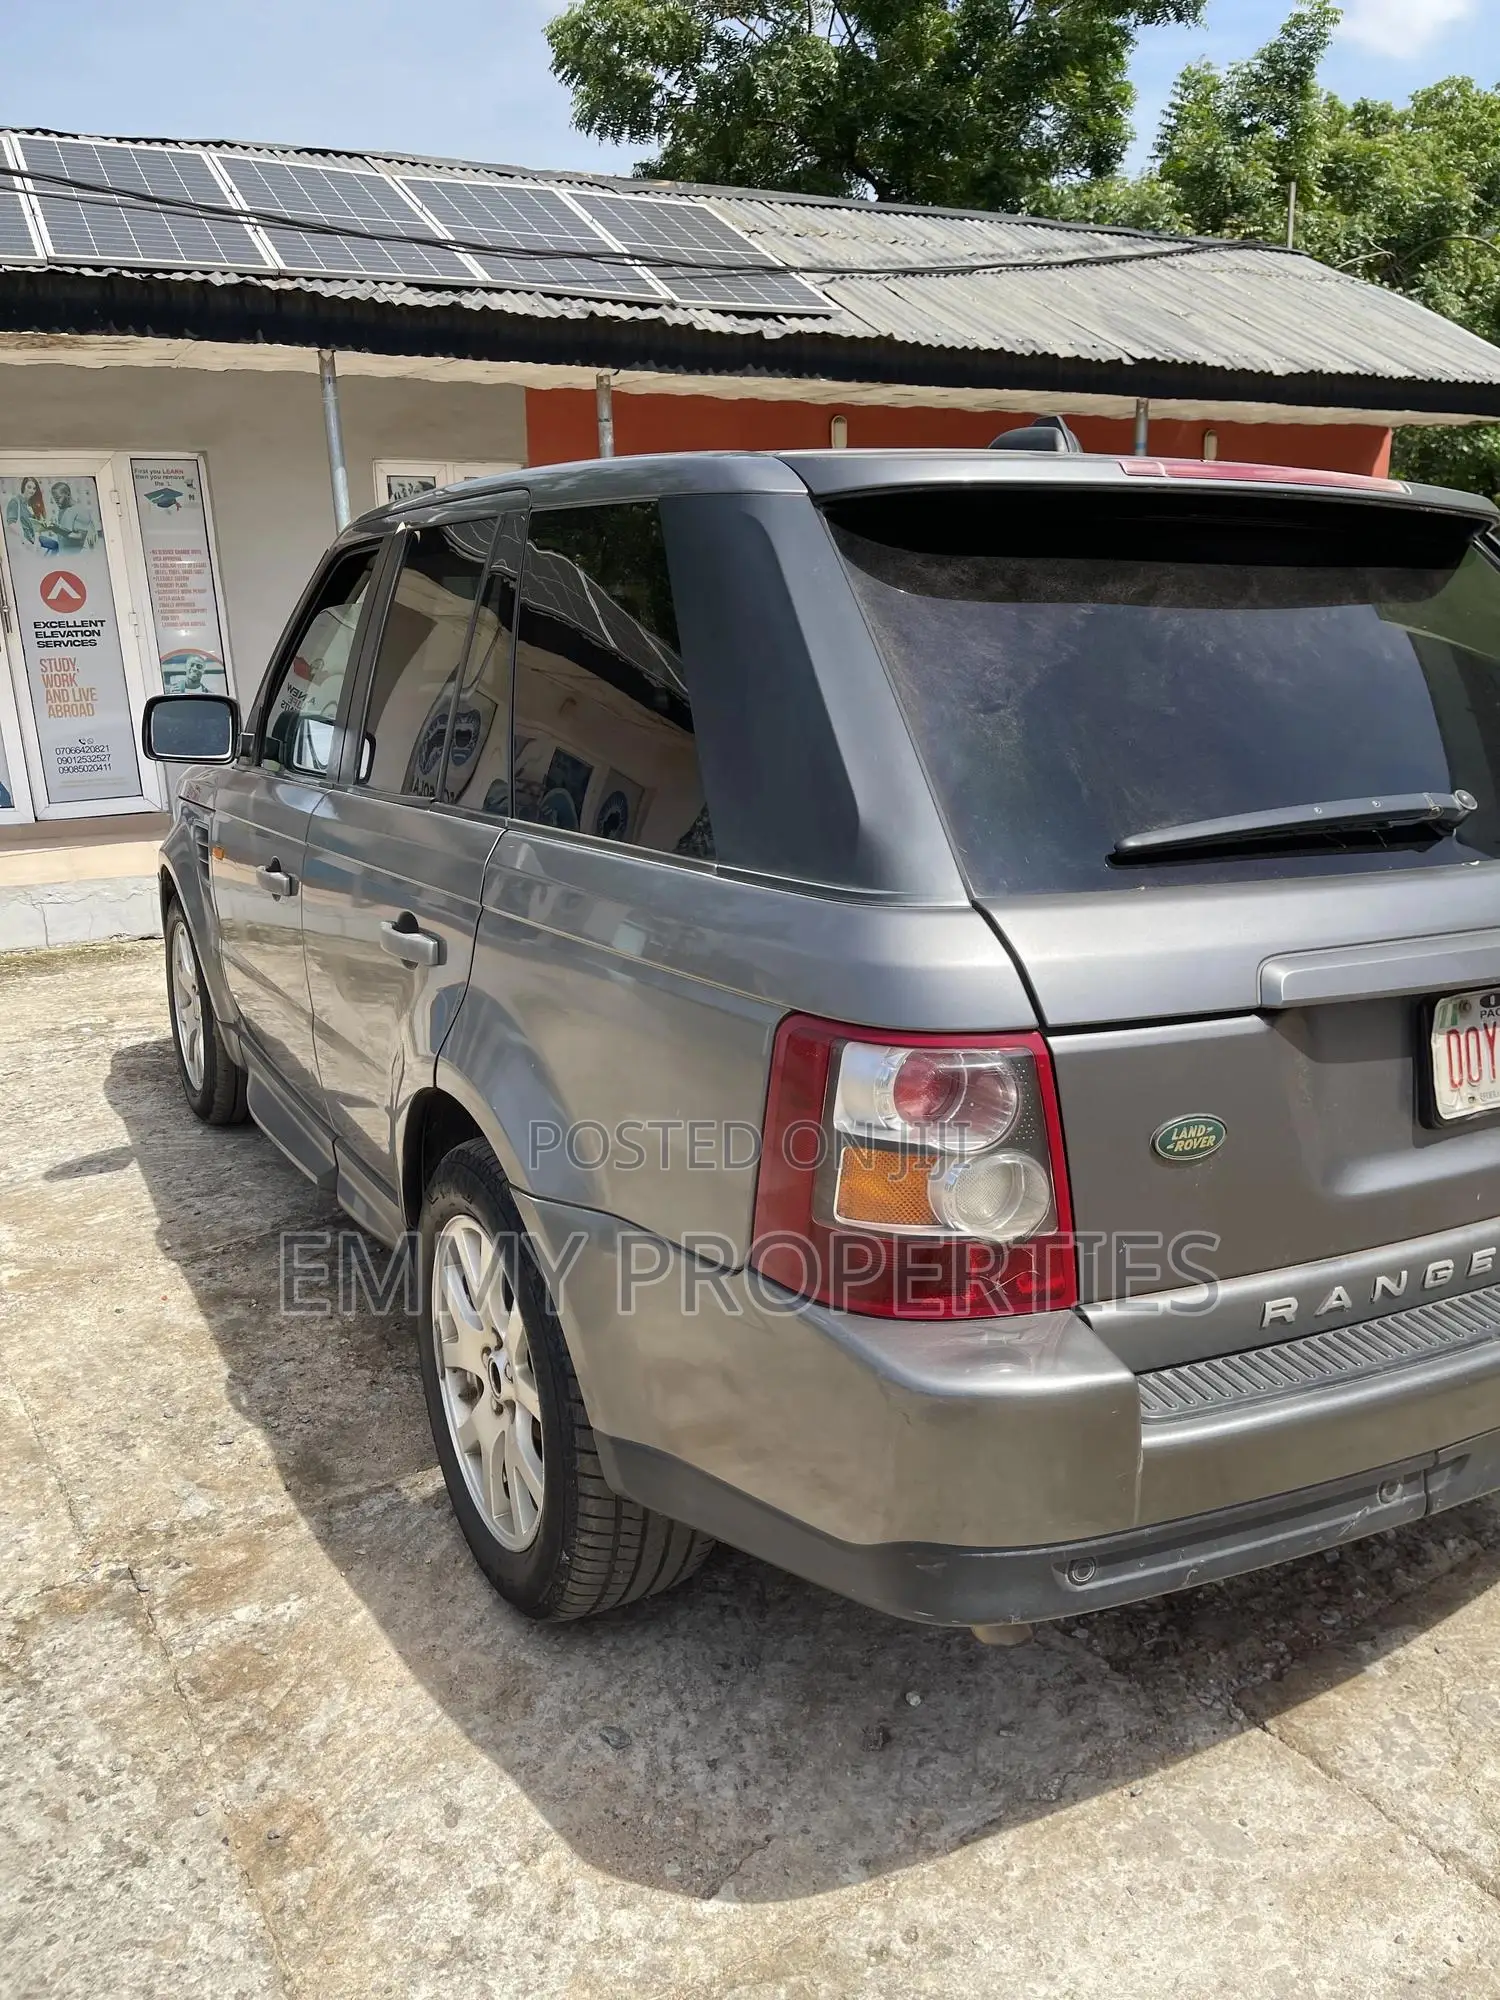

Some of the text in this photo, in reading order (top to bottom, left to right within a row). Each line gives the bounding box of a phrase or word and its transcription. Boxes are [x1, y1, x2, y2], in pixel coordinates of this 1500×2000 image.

[33, 620, 106, 629] EXCELLENT
[35, 629, 101, 639] ELEVATION
[36, 639, 97, 648] SERVICES
[39, 657, 79, 673] STUDY,
[41, 673, 78, 688] WORK
[45, 687, 98, 704] AND LIVE
[48, 703, 95, 719] ABROAD
[55, 744, 110, 755] 07066420821
[56, 754, 111, 765] 09012532527
[58, 763, 112, 774] 09085020411
[1171, 1124, 1206, 1141] LAND
[1173, 1135, 1216, 1152] ROVER
[1260, 1247, 1497, 1329] RANGE
